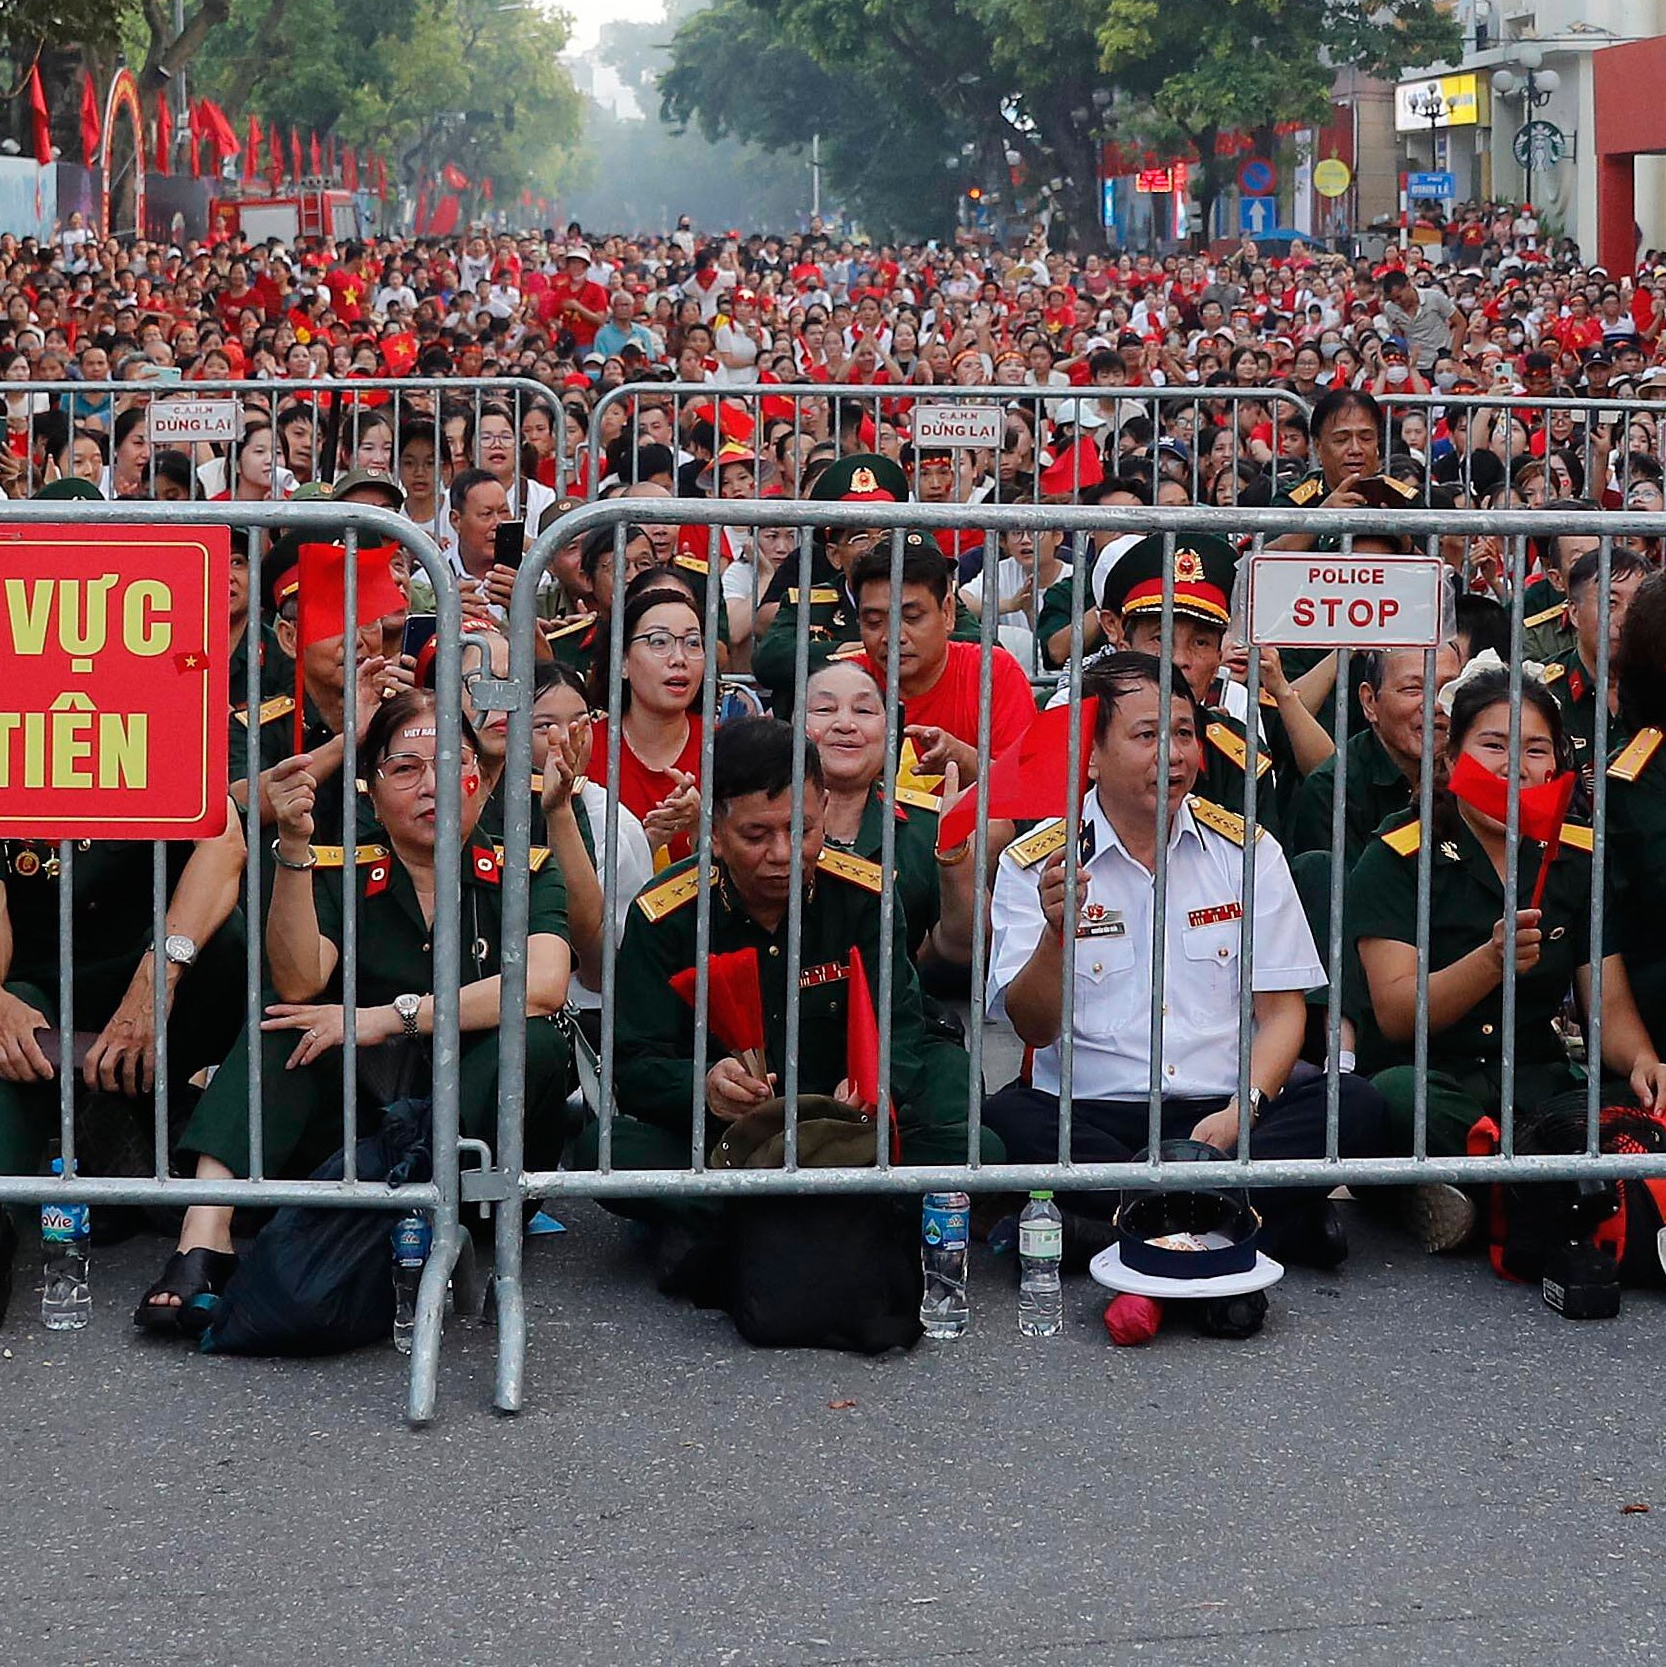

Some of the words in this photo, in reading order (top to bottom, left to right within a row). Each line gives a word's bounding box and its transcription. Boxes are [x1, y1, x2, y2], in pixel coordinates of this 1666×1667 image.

[205, 419, 231, 433] LẠI
[922, 421, 965, 436] DỪNG
[970, 426, 994, 439] LẠI
[1308, 568, 1384, 585] POLICE
[1293, 597, 1399, 628] STOP
[5, 573, 172, 673] VỰC
